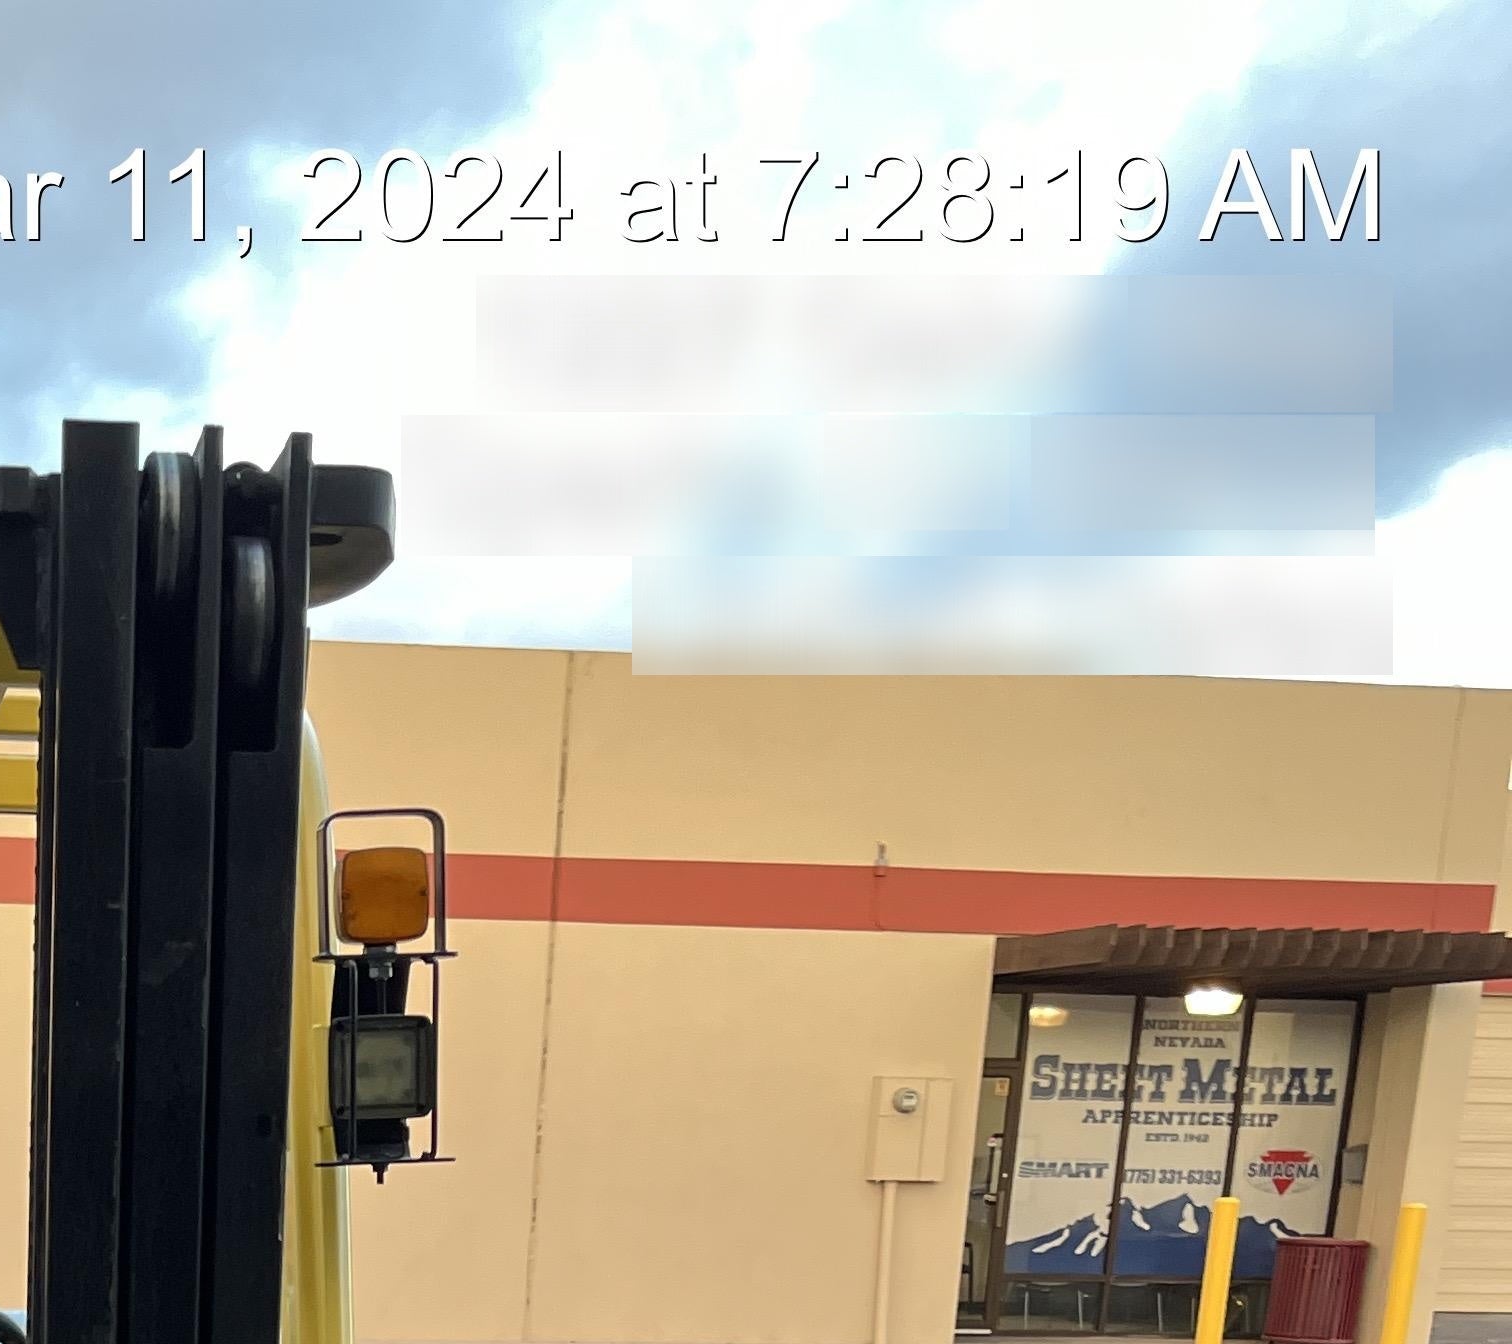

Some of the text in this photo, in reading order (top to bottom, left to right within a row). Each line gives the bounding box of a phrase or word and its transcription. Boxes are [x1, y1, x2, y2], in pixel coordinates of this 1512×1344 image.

[1153, 1035, 1226, 1049] NEVADA
[1018, 1161, 1109, 1178] SMART
[1247, 1162, 1320, 1178] SMACNA
